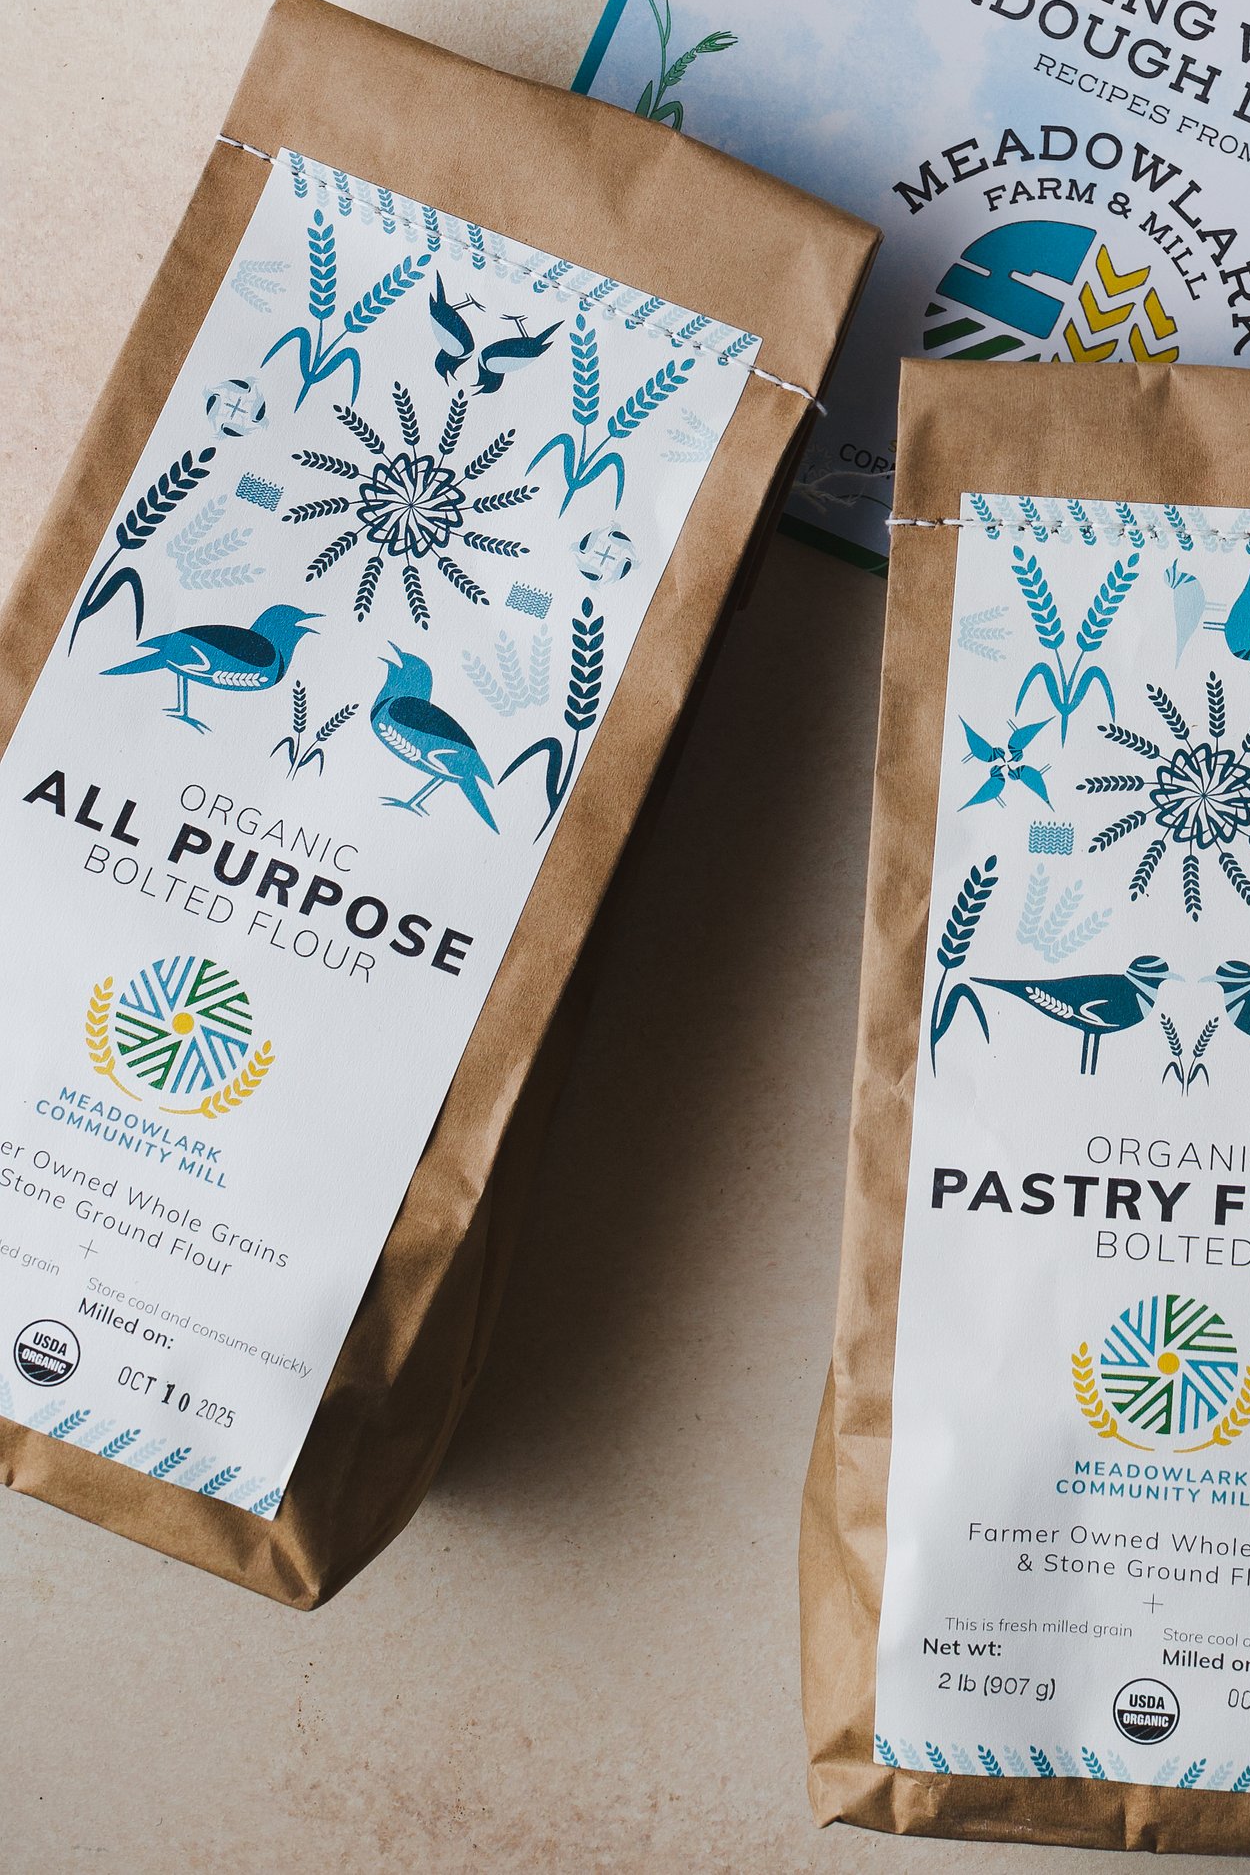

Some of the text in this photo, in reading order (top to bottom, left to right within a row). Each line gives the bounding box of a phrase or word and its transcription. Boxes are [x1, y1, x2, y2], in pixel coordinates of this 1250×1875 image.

[1034, 53, 1170, 124] RECIPES
[983, 178, 1208, 301] FARM & MILL
[181, 784, 358, 872] ORGANIC
[23, 770, 474, 977] ALL PURPOSE
[85, 844, 375, 983] BOLTED FLOUR
[36, 1100, 172, 1163] COMMUNITY
[178, 1157, 226, 1188] MILL
[59, 1086, 222, 1163] MEADOWLARK
[931, 1167, 1191, 1222] PASTRY
[1056, 1478, 1200, 1503] COMMUNITY
[1075, 1460, 1247, 1486] MEADOWLARK
[969, 1523, 1060, 1543] Farmer
[1071, 1526, 1158, 1550] Owned
[1044, 1554, 1115, 1575] Stone
[1128, 1560, 1218, 1584] Ground
[923, 1638, 1001, 1656] Net wt:
[1163, 1628, 1203, 1644] Store
[1208, 1633, 1238, 1647] cool
[1163, 1649, 1224, 1671] Milled
[938, 1672, 1055, 1702] 2 lb (907 g)
